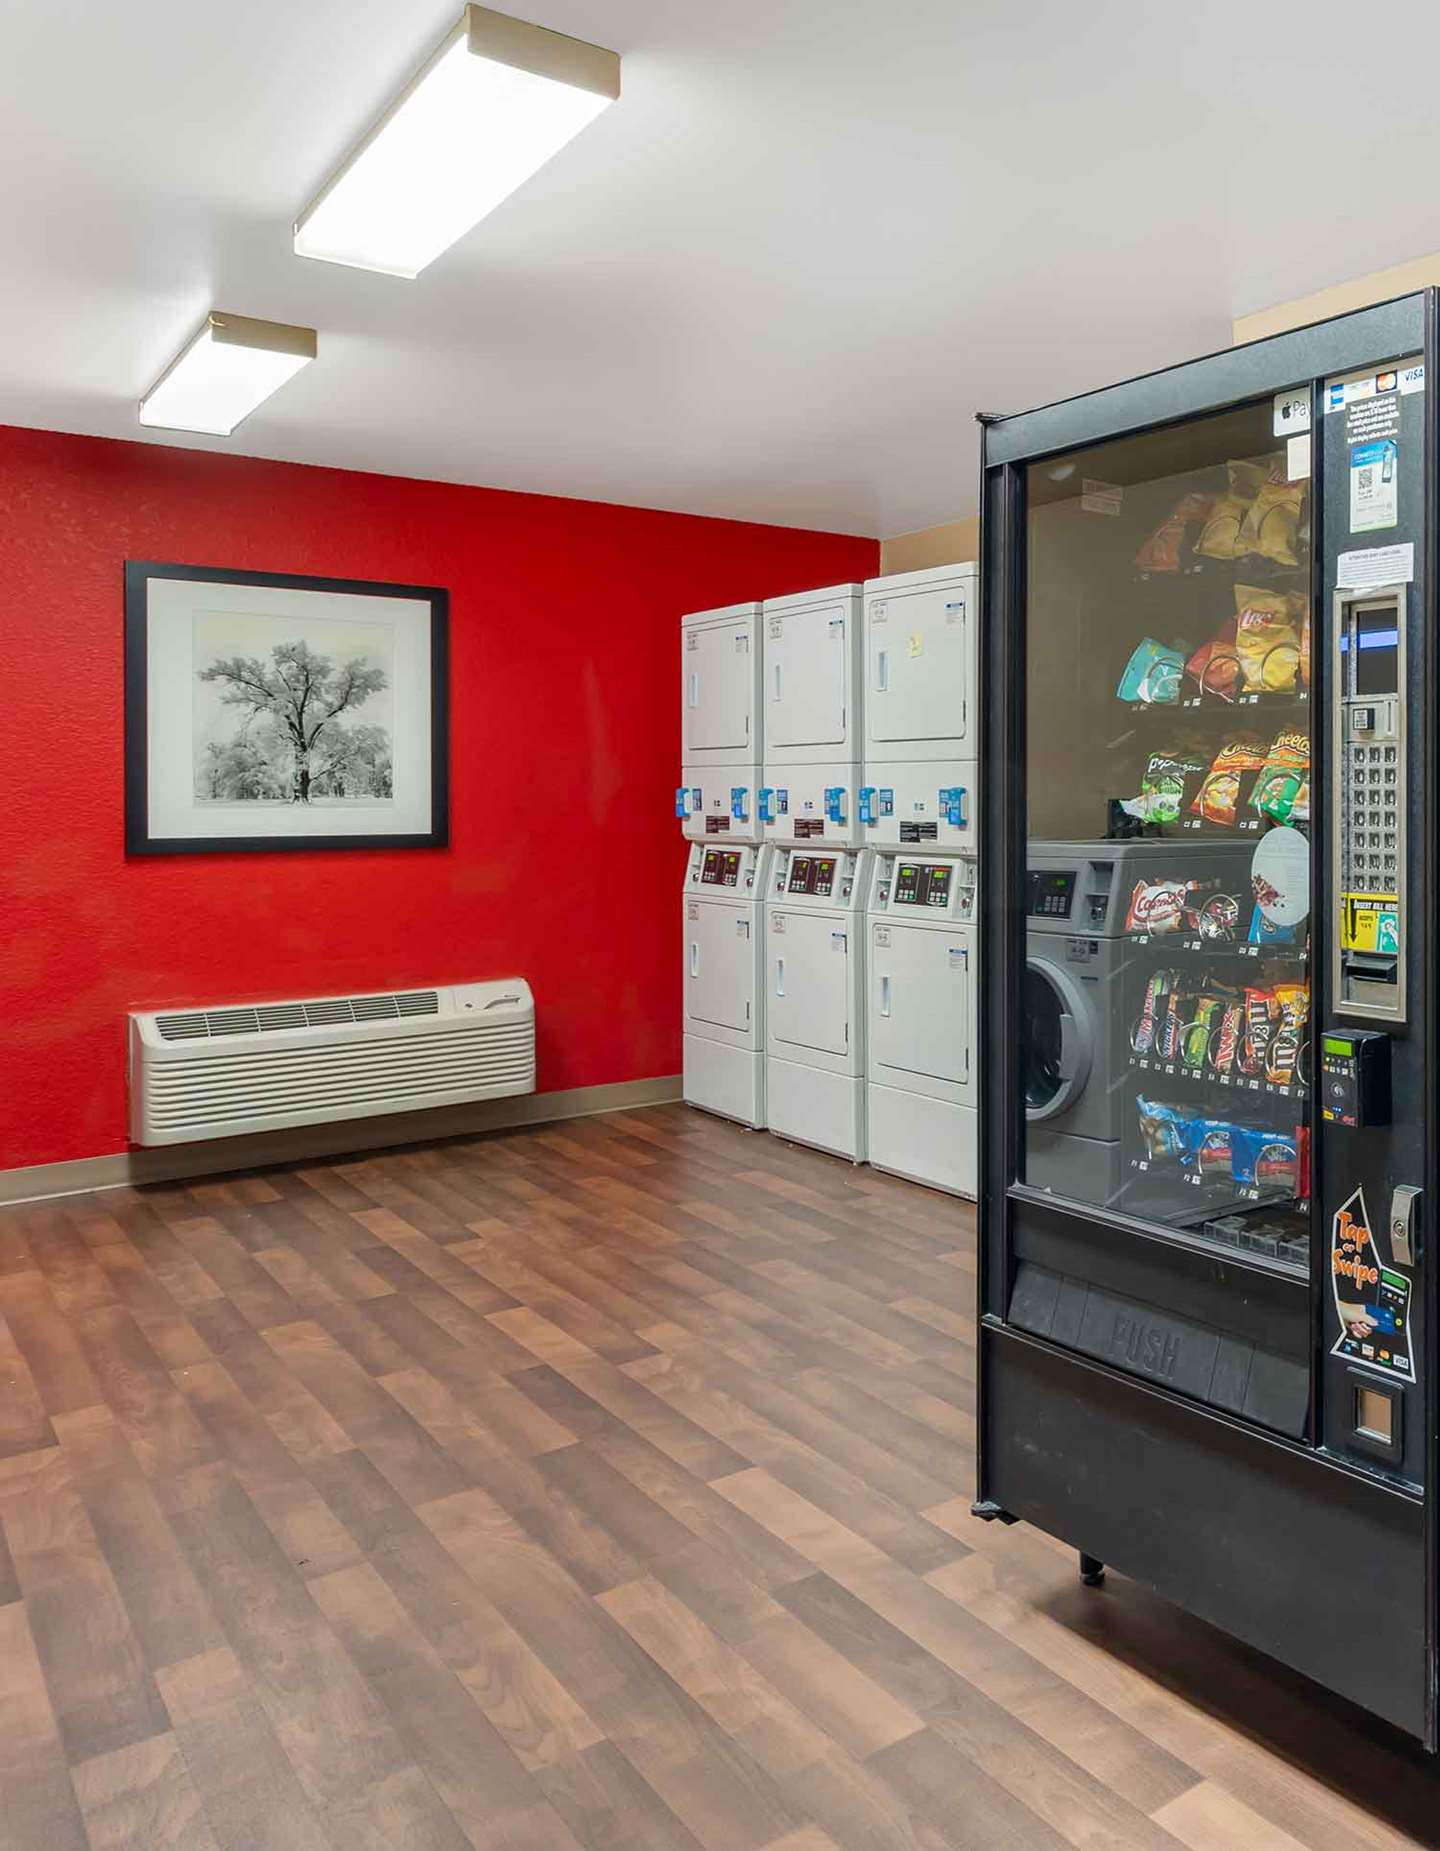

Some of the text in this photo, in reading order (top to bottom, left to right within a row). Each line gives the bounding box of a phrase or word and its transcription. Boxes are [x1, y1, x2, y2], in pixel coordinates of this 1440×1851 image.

[1405, 368, 1424, 381] VISA
[1293, 400, 1311, 418] Pay
[1338, 1211, 1370, 1253] Tap
[1333, 1249, 1378, 1290] Swipe
[1113, 1316, 1181, 1382] PUSH
[1395, 1357, 1409, 1368] VISA
